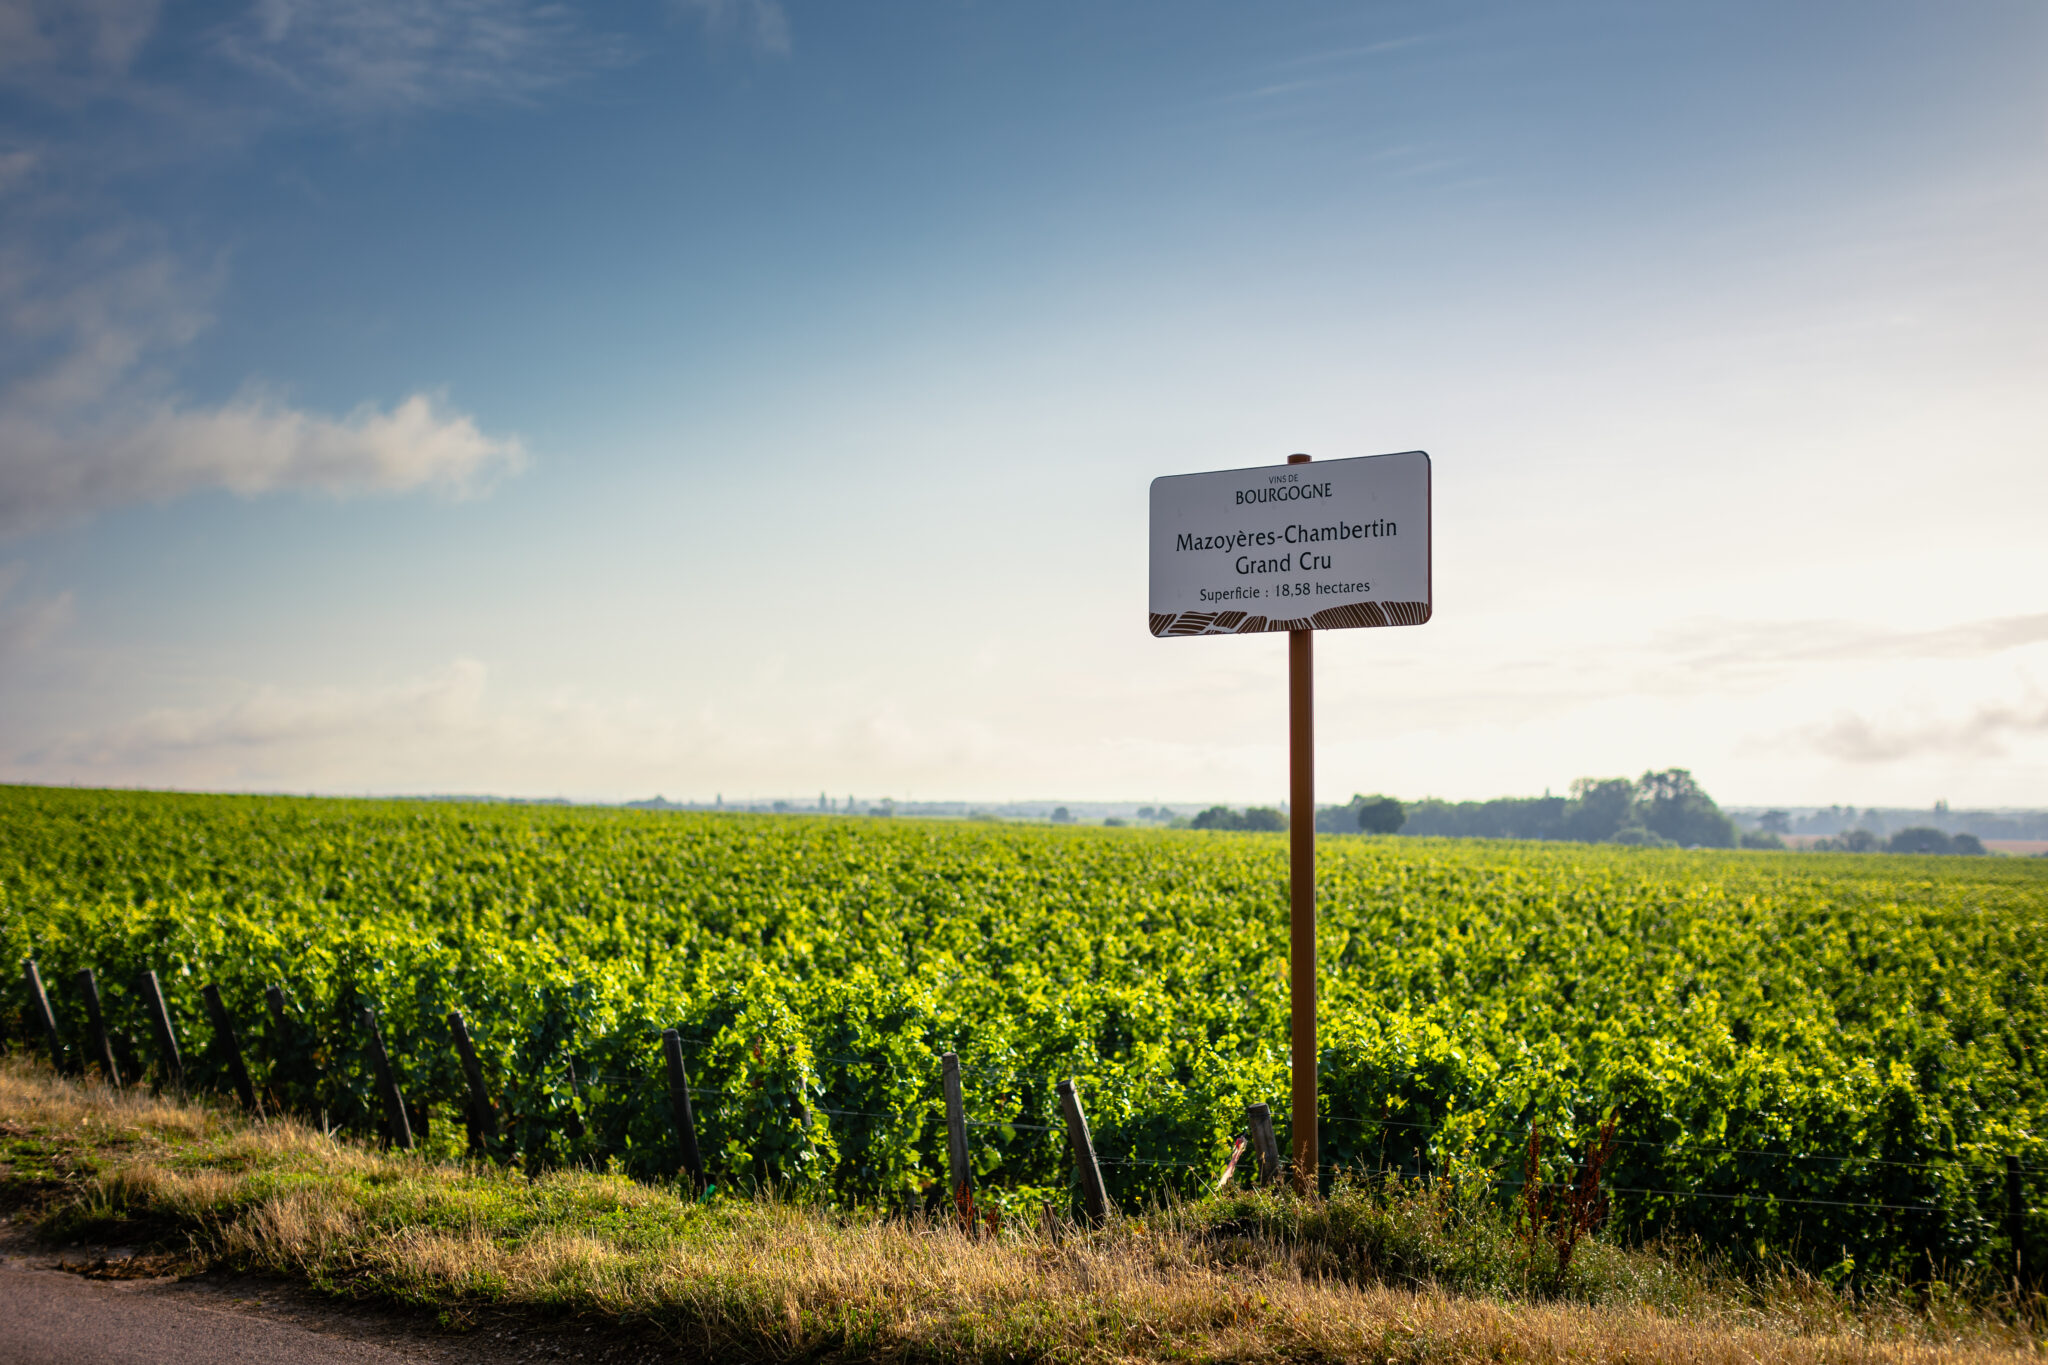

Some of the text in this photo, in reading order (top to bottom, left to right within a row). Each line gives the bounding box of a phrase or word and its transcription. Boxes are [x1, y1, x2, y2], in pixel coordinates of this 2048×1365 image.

[1268, 474, 1299, 484] VINS DE
[1235, 483, 1333, 505] BOURGOGNE
[1175, 518, 1398, 554] Mazoyères-Chambertin
[1235, 551, 1332, 575] Grand Cru
[1199, 586, 1261, 604] Superficie
[1315, 581, 1371, 595] hectares
